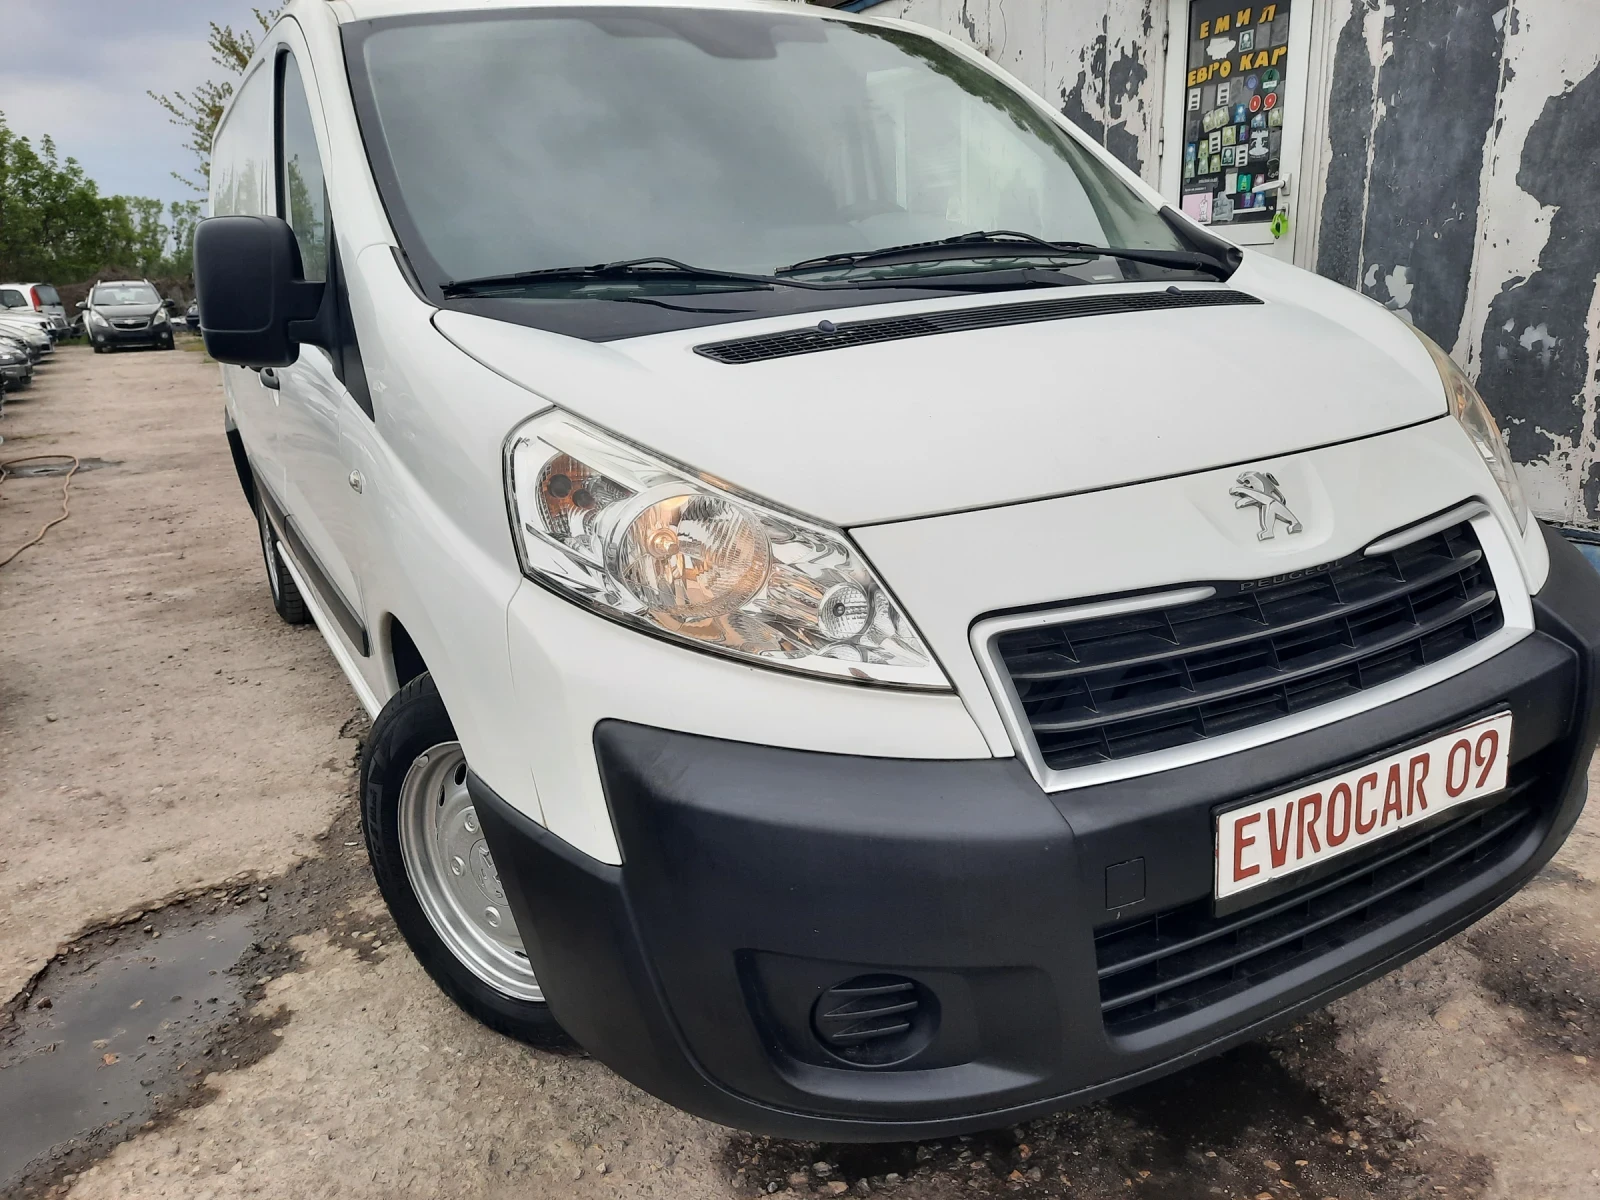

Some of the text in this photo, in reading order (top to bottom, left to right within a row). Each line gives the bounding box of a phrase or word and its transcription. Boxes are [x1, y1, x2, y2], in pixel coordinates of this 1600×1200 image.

[1200, 4, 1276, 39] ЕМИЛ
[1187, 46, 1287, 87] ЕВРО КАР
[1249, 92, 1277, 113] 09
[1233, 729, 1499, 882] EVROCAR 09
